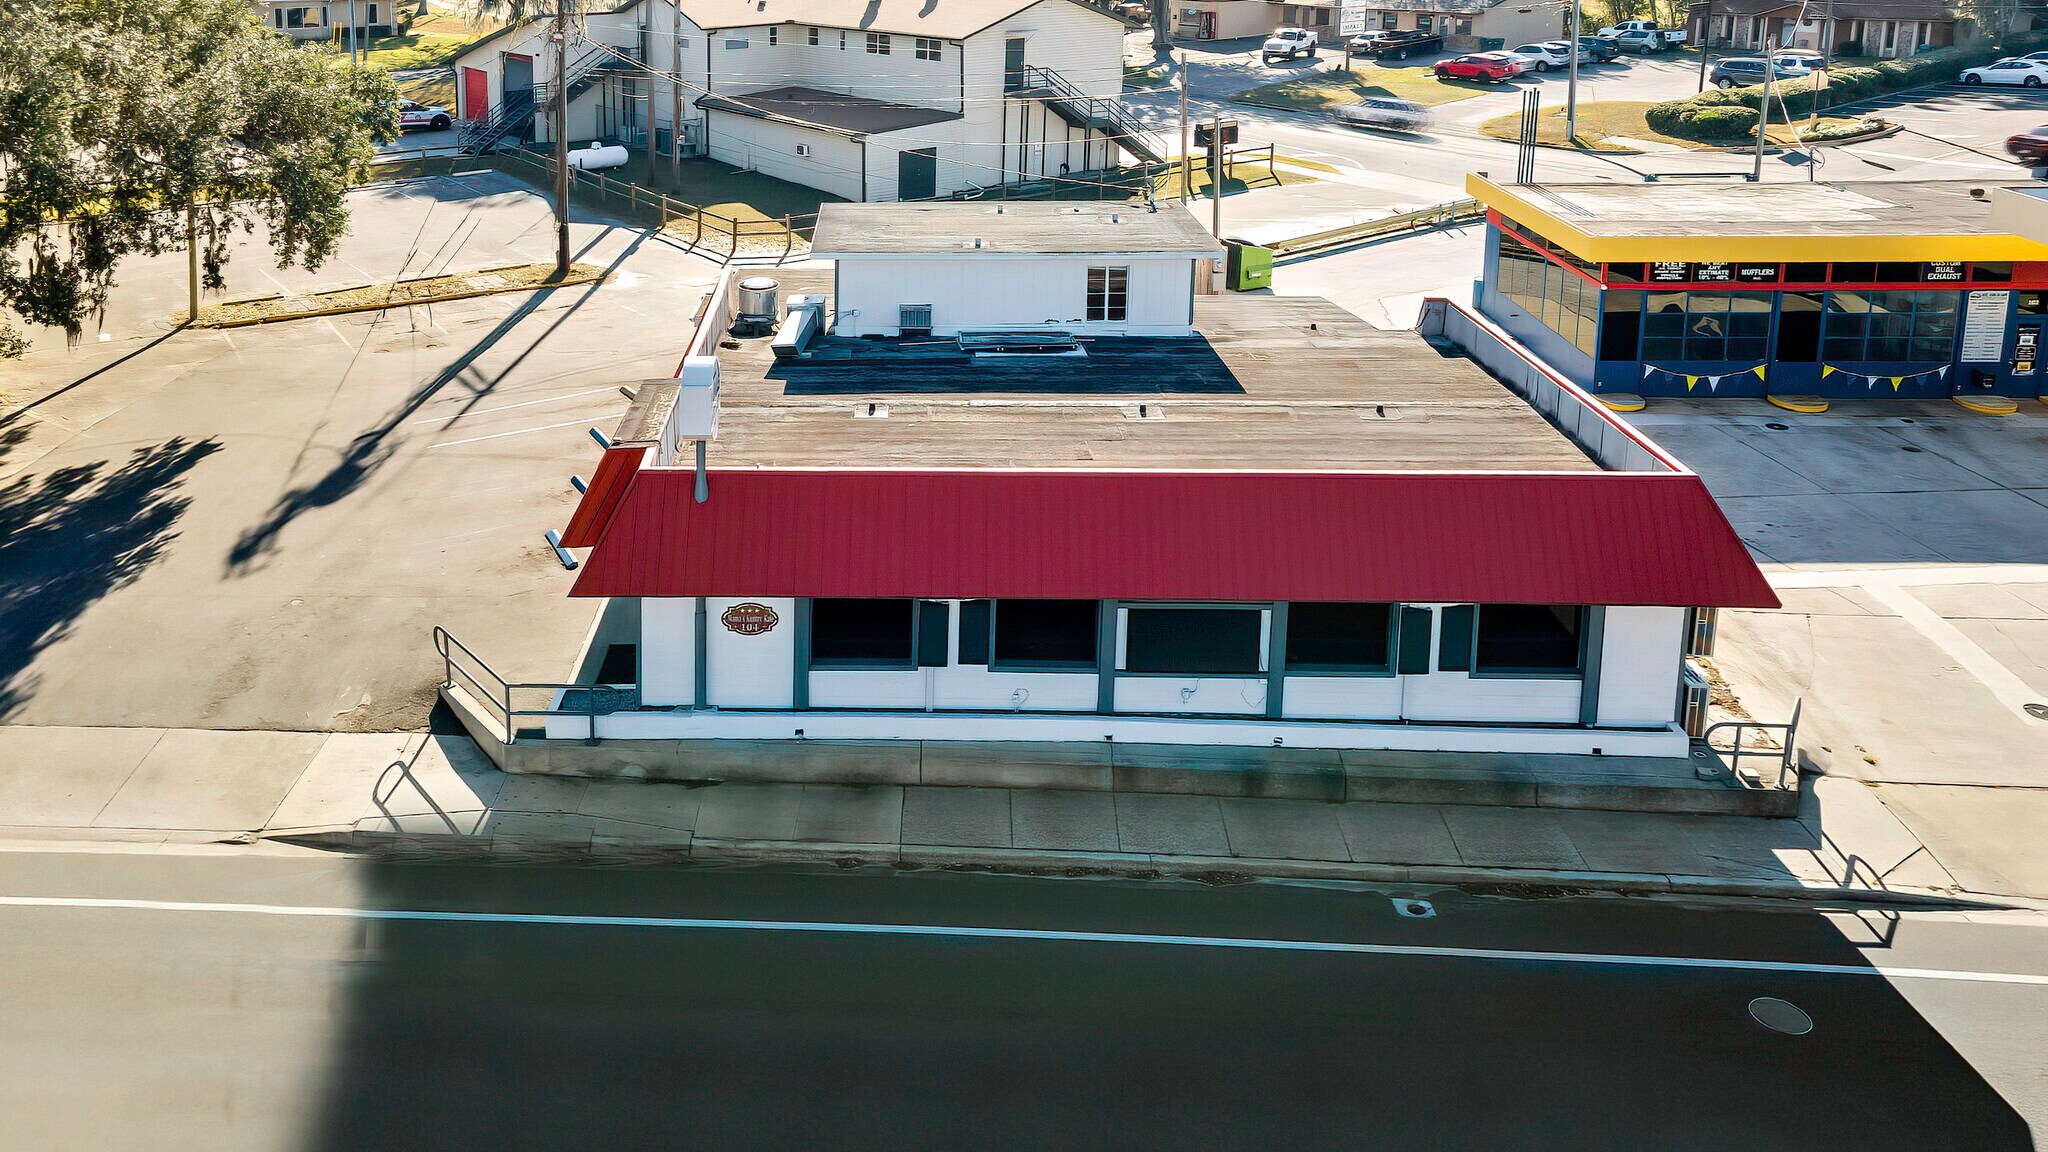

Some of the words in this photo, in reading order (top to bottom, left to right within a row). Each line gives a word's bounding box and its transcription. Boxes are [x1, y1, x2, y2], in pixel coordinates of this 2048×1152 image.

[1741, 268, 1774, 276] MUFFLERS
[1927, 272, 1962, 280] EXHAUST
[741, 623, 758, 631] 104
